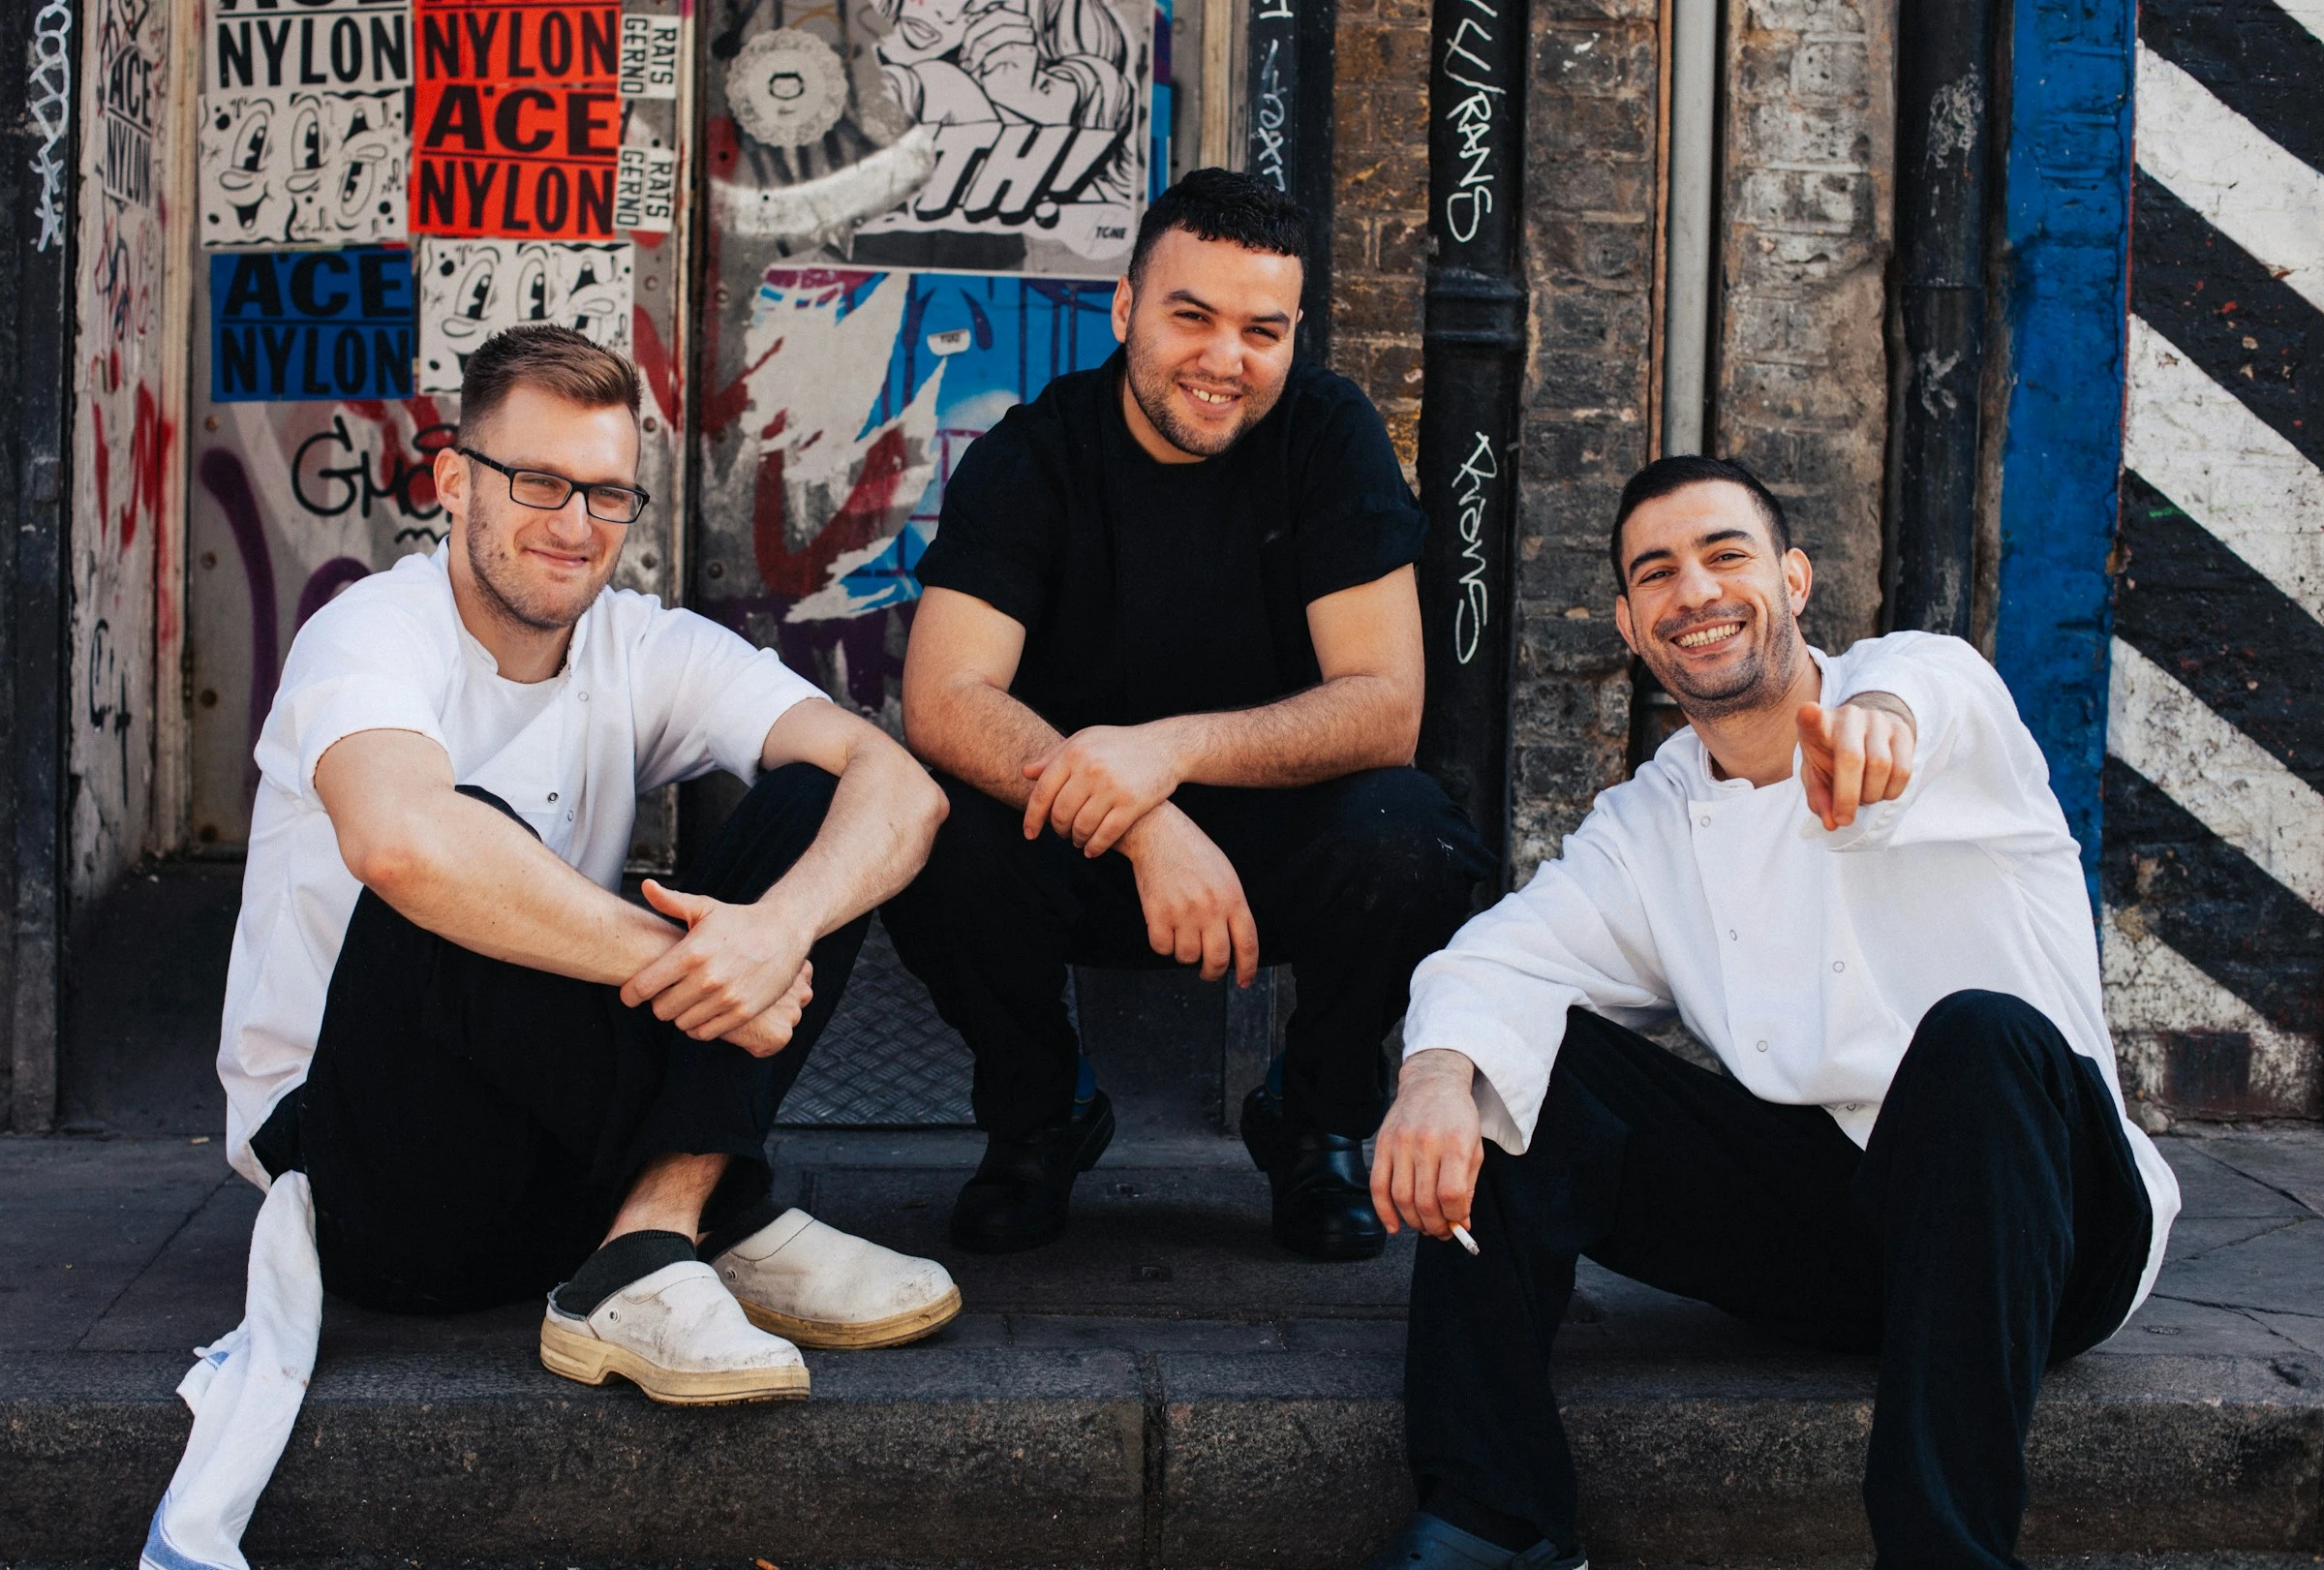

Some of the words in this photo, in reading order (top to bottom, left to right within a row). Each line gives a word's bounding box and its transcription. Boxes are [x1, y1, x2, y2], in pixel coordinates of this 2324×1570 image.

[217, 14, 408, 88] NYLON
[423, 10, 619, 79] NYLON
[650, 26, 677, 84] RATS
[108, 48, 153, 128] ACE
[423, 84, 618, 156] ACE
[418, 159, 614, 235] NYLON
[646, 160, 673, 218] RATS
[222, 253, 412, 318] ACE
[220, 325, 410, 394] NYLON
